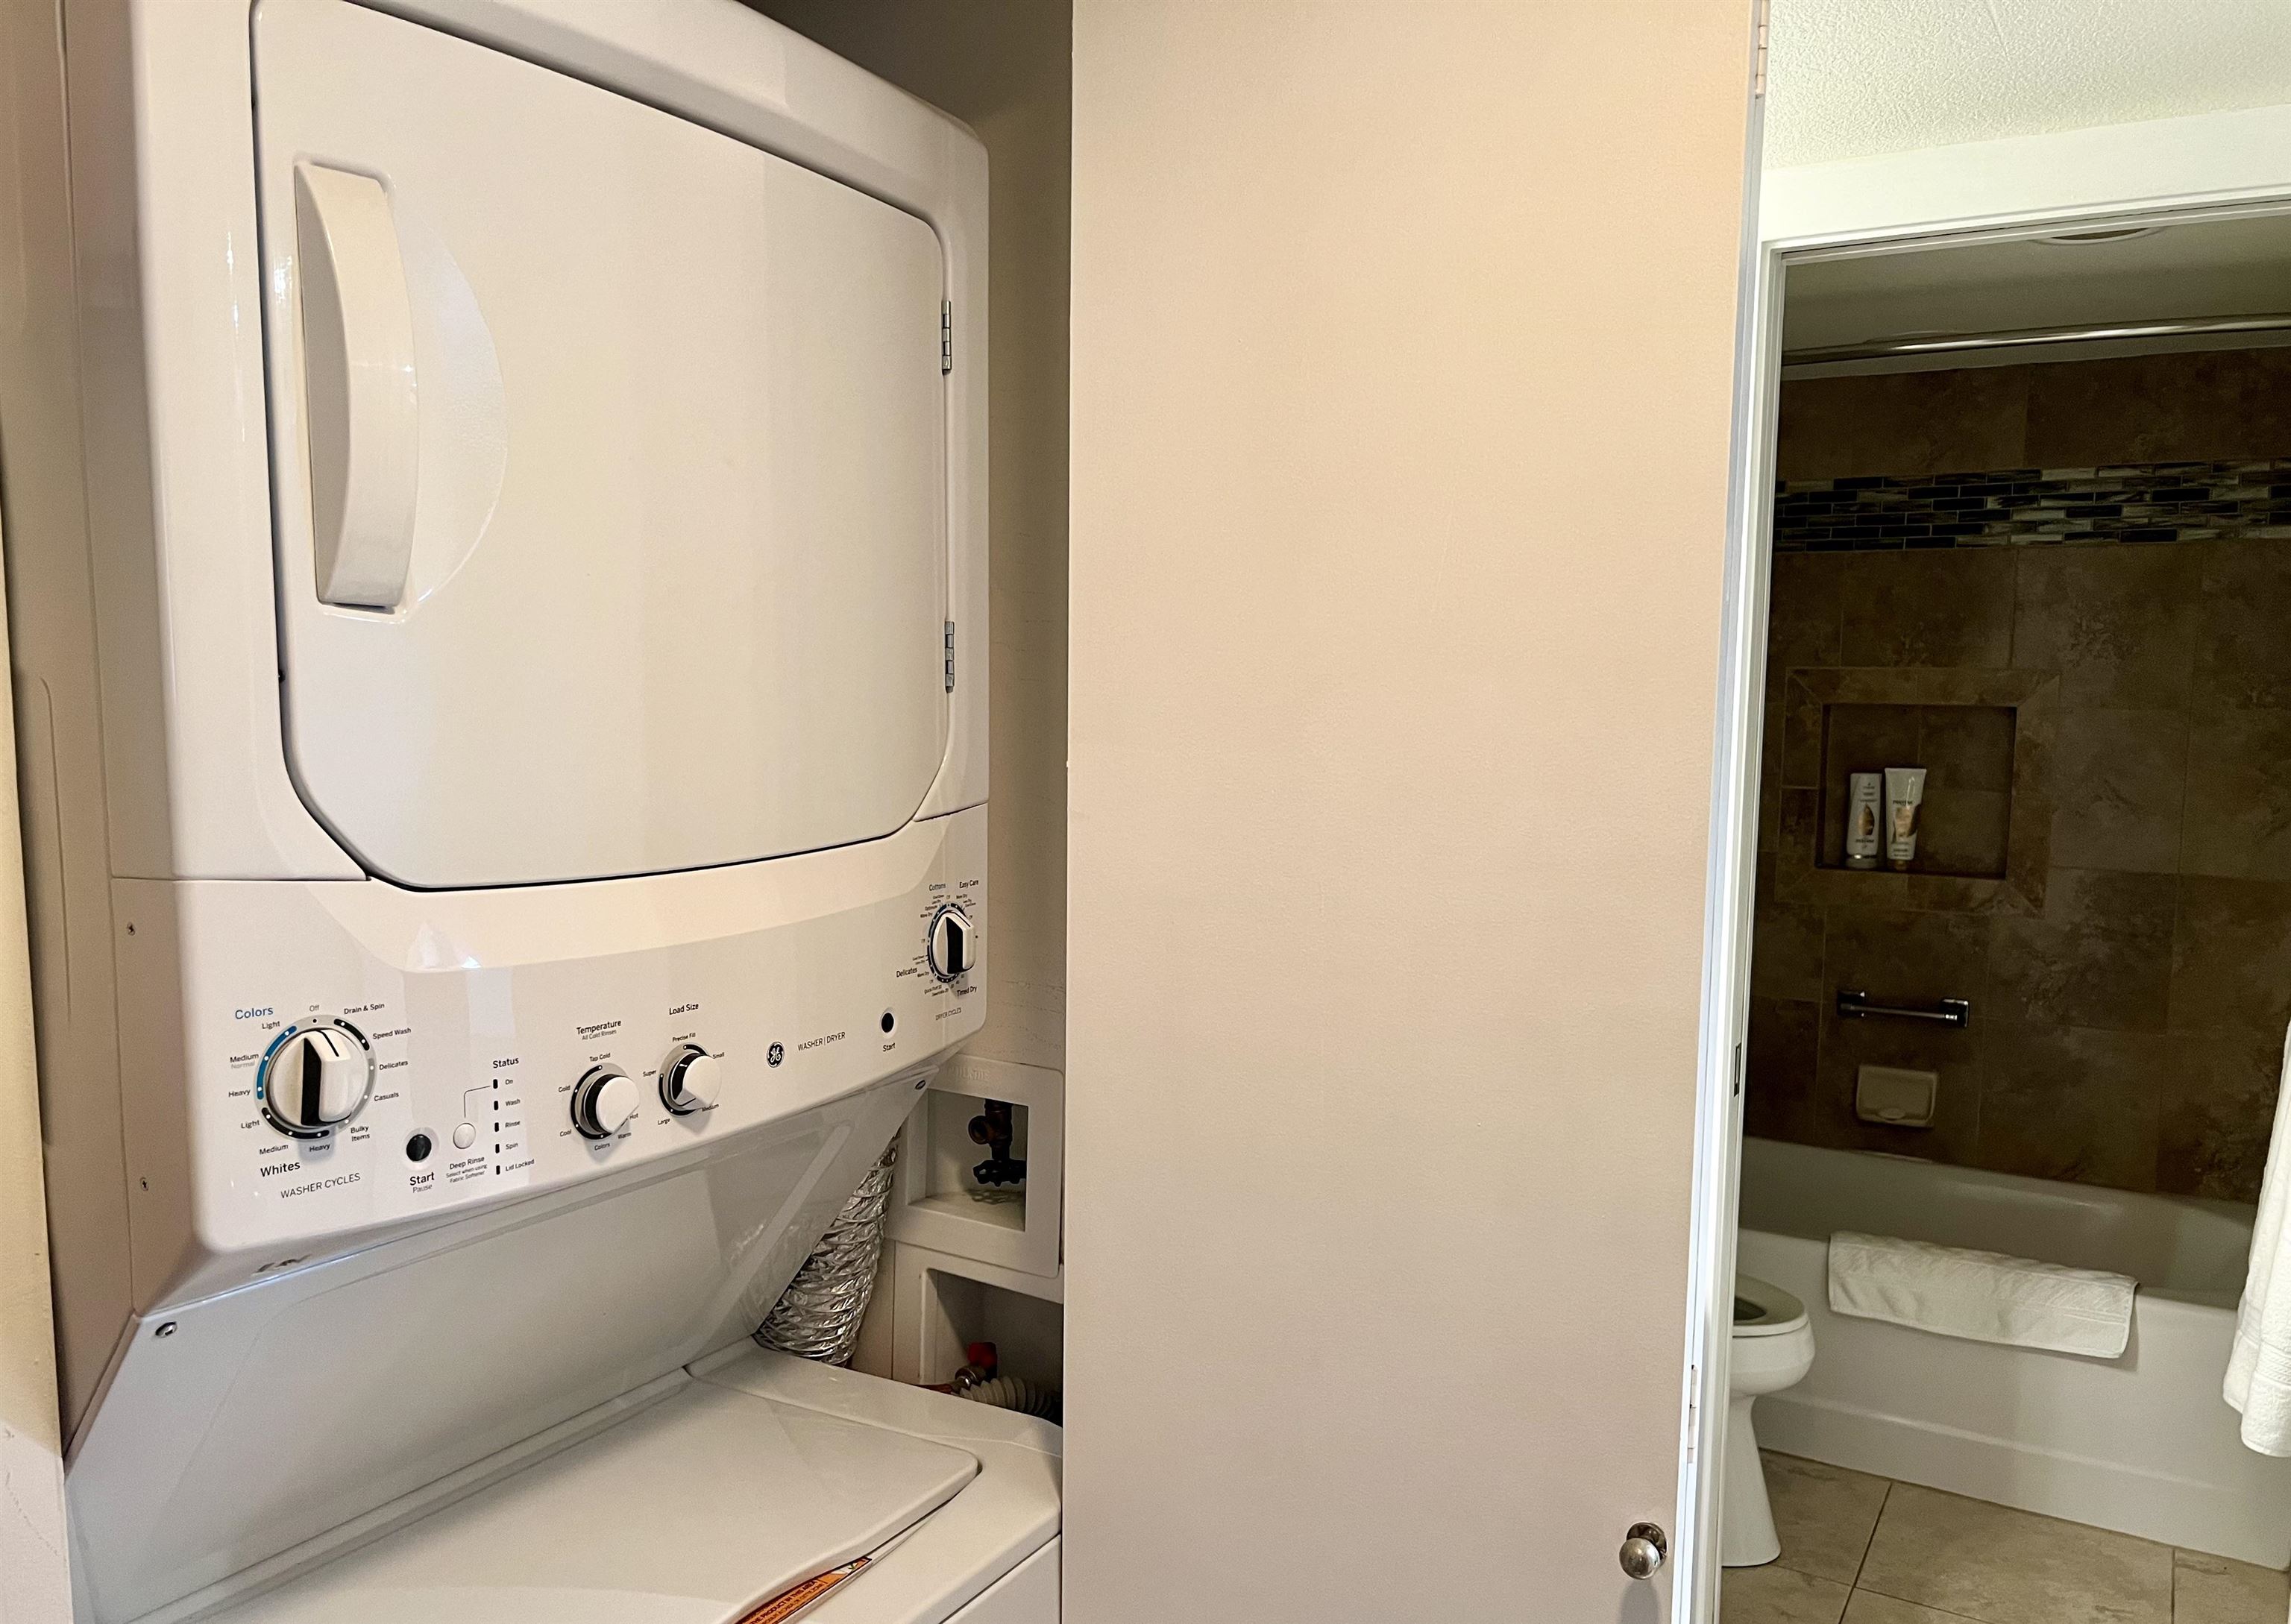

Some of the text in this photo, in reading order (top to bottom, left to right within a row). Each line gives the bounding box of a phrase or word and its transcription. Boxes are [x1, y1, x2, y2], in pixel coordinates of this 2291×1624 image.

[959, 881, 969, 889] Easy
[896, 968, 917, 978] Delicates
[957, 986, 969, 997] Timed
[969, 985, 978, 994] Dry
[235, 1007, 274, 1020] Colors
[309, 1004, 320, 1013] Off
[343, 1007, 362, 1015] Drain
[369, 1003, 385, 1012] Spin
[669, 1003, 699, 1015] Load Size
[262, 1020, 280, 1030] Light
[576, 1020, 621, 1034] Temperature
[372, 1027, 412, 1040] Speed Wash
[797, 1031, 846, 1051] WASHER DRYER
[882, 1042, 896, 1052] Start
[230, 1053, 259, 1063] Medium
[492, 1057, 519, 1068] Status
[230, 1060, 255, 1070] Normal
[379, 1060, 409, 1071] Delicates
[228, 1089, 251, 1098] Heavy
[374, 1092, 400, 1102] Casuals
[505, 1098, 521, 1107] Wash
[240, 1119, 260, 1129] Light
[505, 1120, 521, 1128] Rinse
[350, 1125, 369, 1135] Bulky
[351, 1133, 371, 1142] Items
[259, 1144, 289, 1155] Medium
[309, 1142, 330, 1153] Heavy
[505, 1142, 518, 1151] Spin
[450, 1156, 485, 1170] Deep Rinse
[515, 1159, 535, 1169] Locked
[260, 1161, 301, 1177] Whites
[409, 1172, 435, 1186] Start
[280, 1173, 361, 1199] WASHER CYCLES
[412, 1183, 433, 1193] Pause
